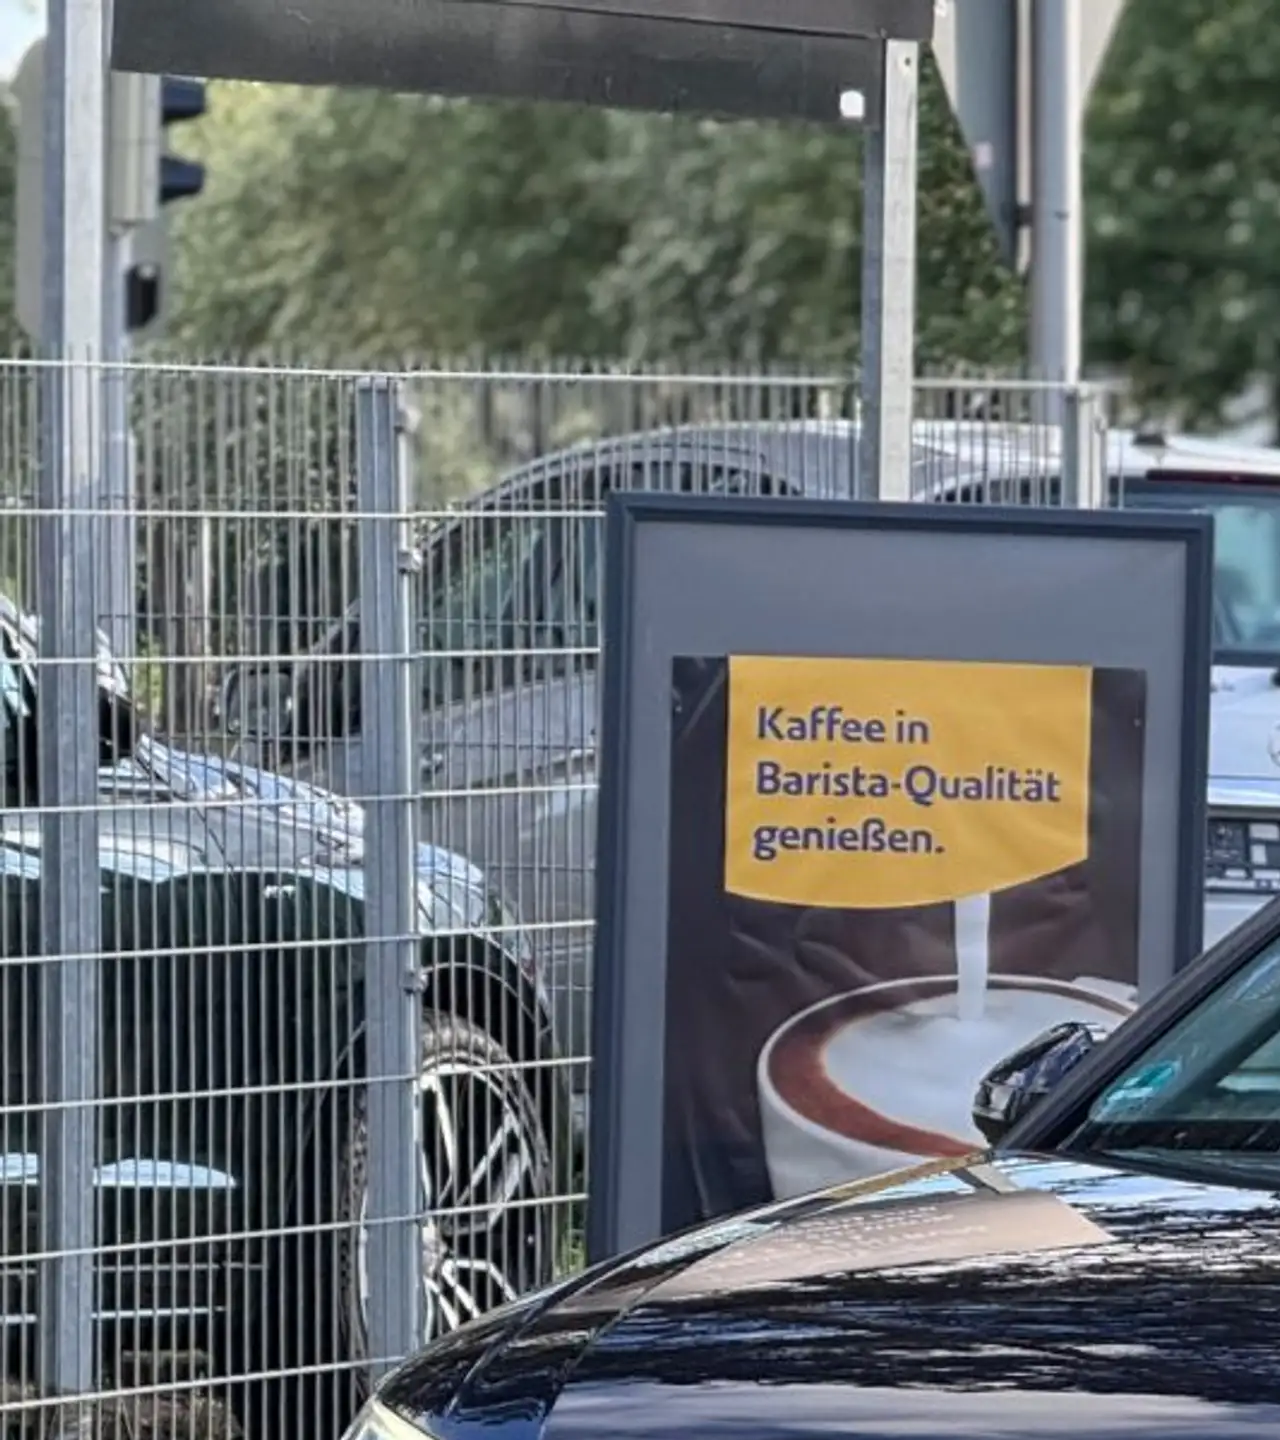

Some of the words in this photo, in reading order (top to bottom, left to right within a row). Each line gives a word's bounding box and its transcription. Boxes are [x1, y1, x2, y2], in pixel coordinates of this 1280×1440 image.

[757, 705, 886, 742] Kaffee
[896, 709, 930, 744] in
[756, 760, 1062, 807] Barista-Qualität
[754, 817, 945, 861] genießen.
